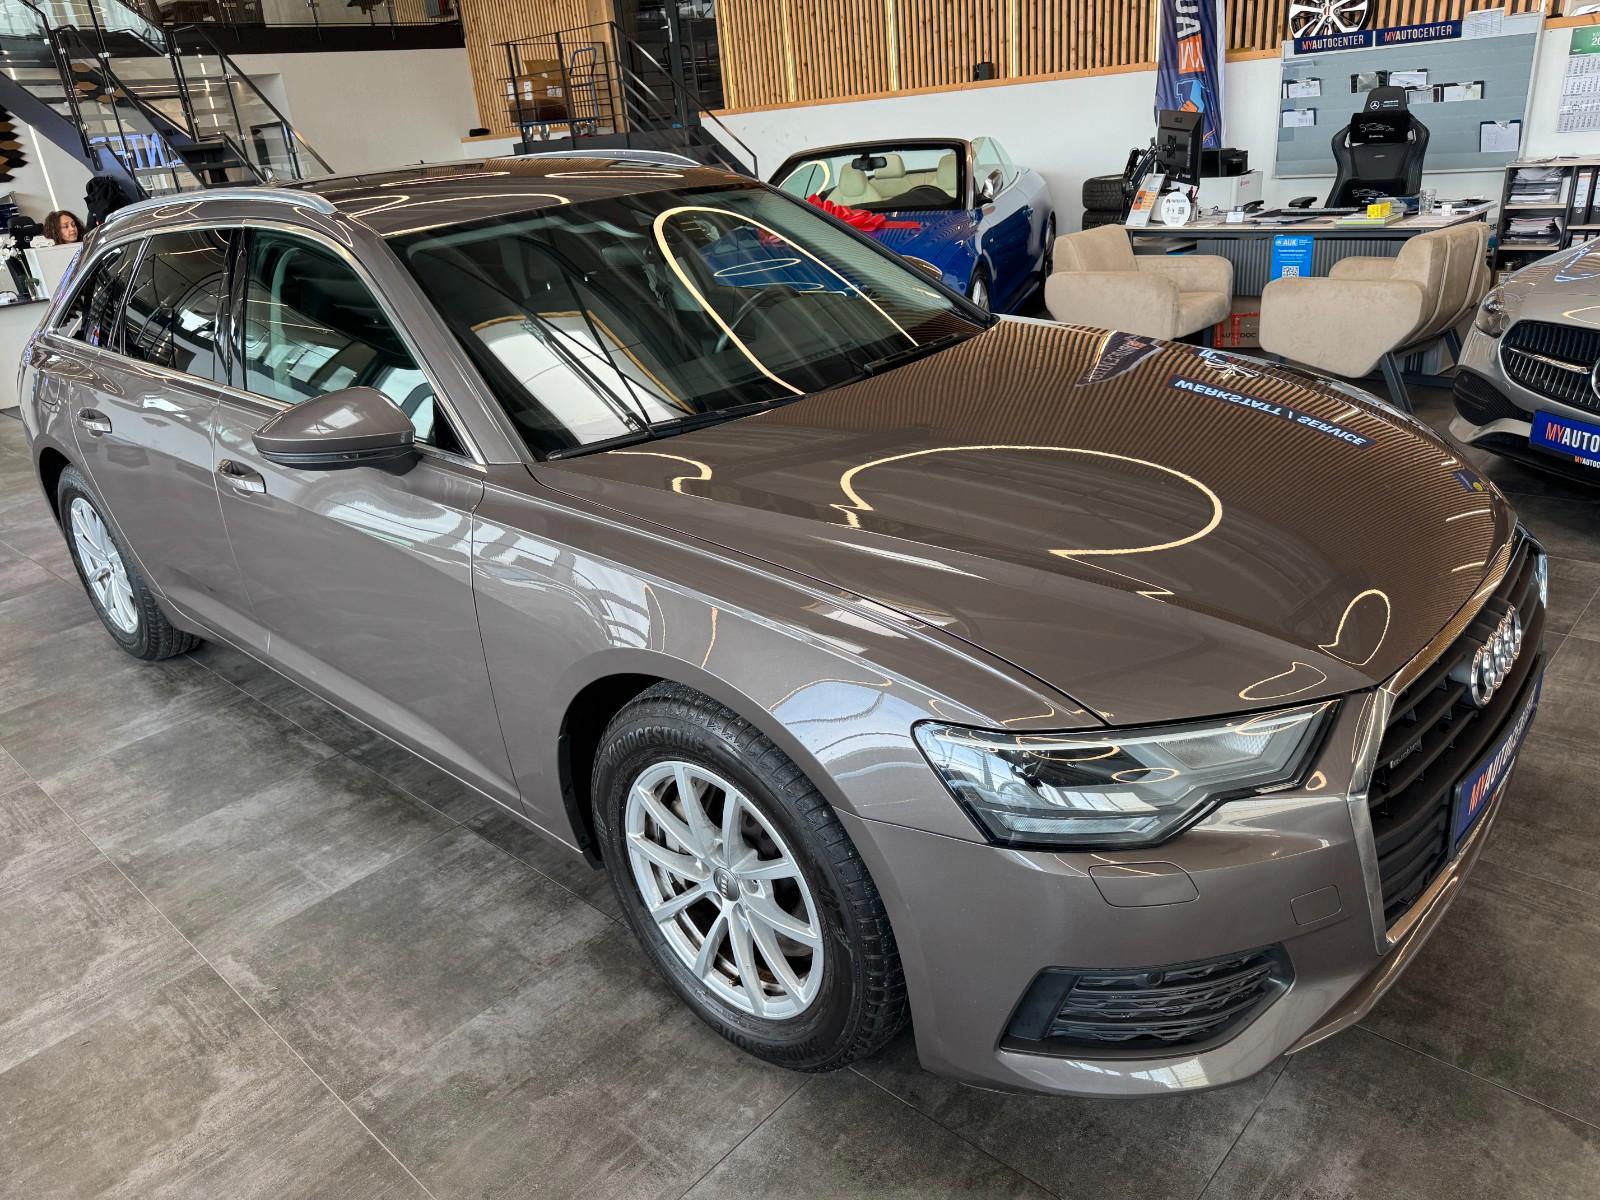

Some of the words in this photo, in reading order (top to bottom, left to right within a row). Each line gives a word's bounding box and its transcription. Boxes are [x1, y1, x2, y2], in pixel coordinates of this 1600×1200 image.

[1384, 24, 1453, 42] MYAUTOCENTER
[1302, 35, 1364, 51] MYAUTOCENTER
[1545, 421, 1600, 453] MYAUTO
